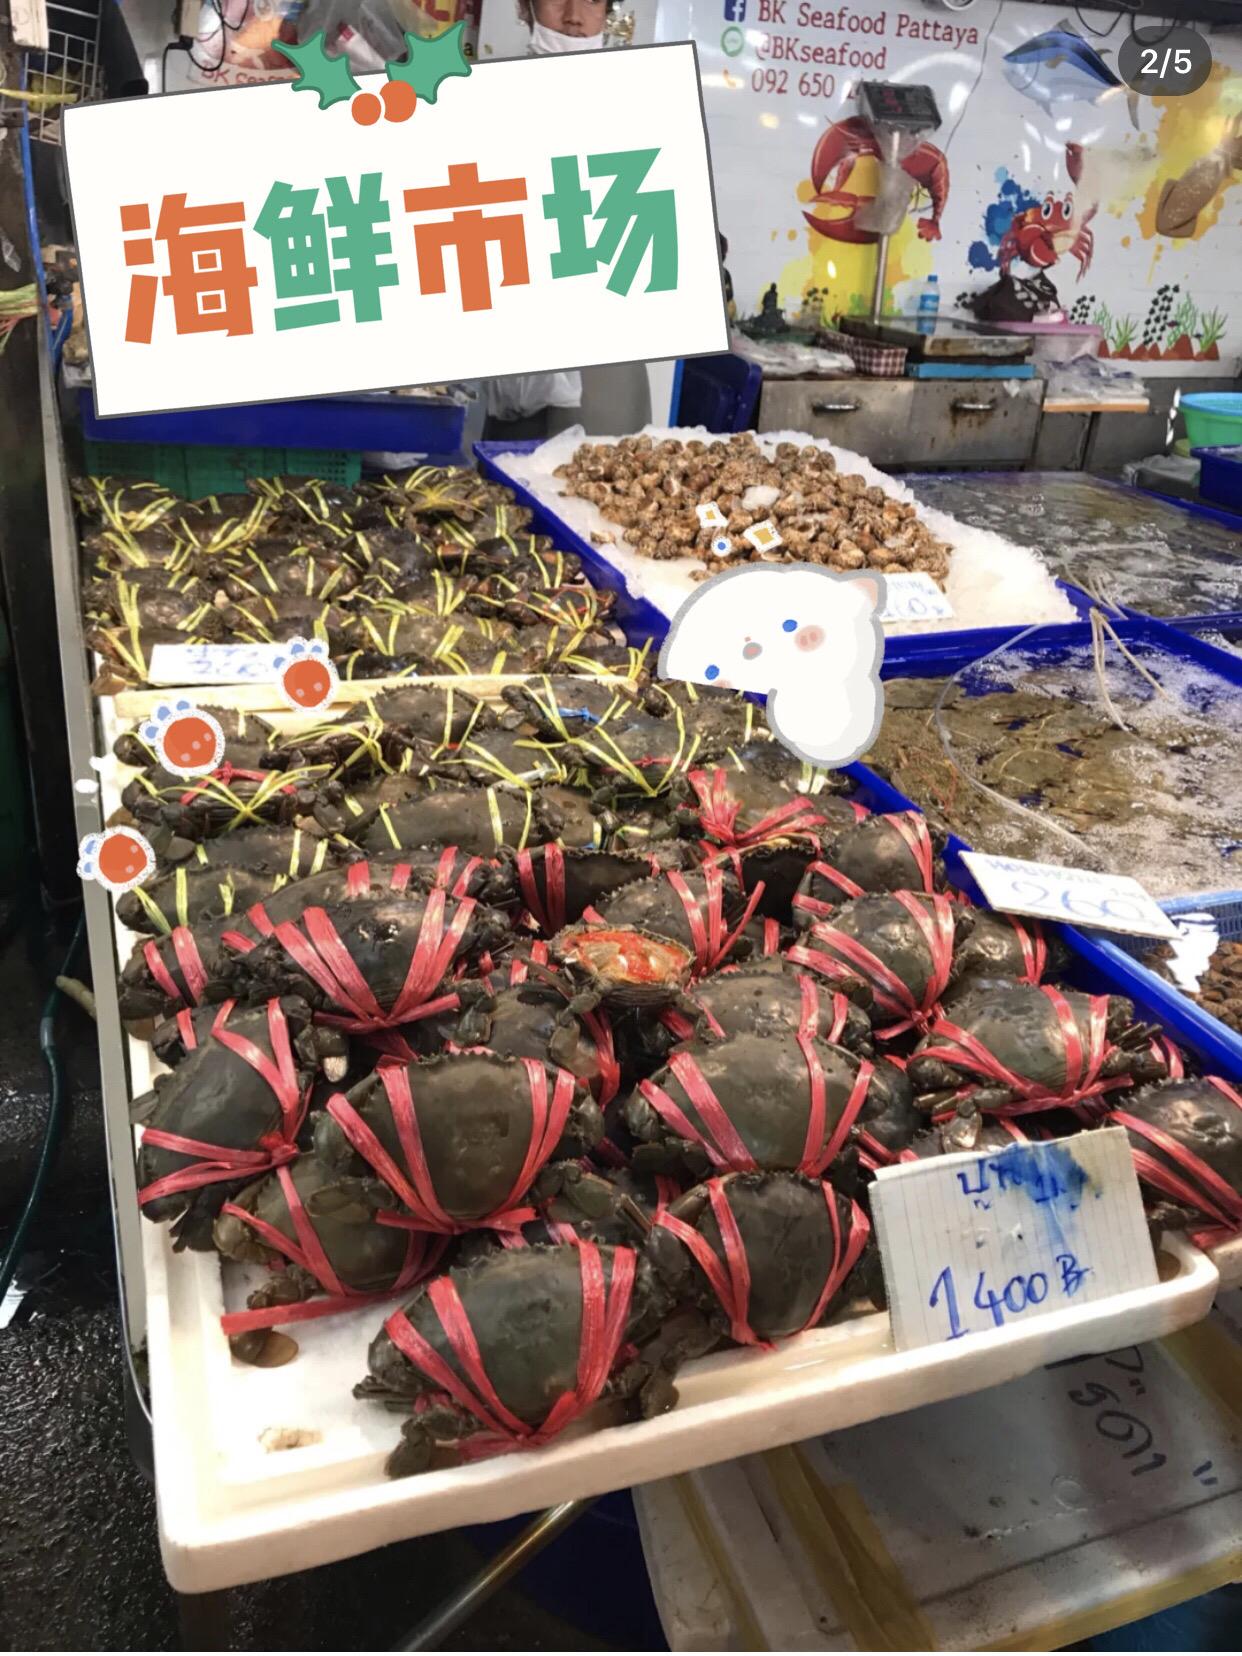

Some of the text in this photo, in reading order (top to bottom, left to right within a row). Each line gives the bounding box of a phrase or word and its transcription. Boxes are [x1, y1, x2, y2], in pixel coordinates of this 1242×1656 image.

[757, 0, 979, 49] BK Seafood Pattaya
[751, 68, 788, 94] 092
[798, 71, 836, 98] 650
